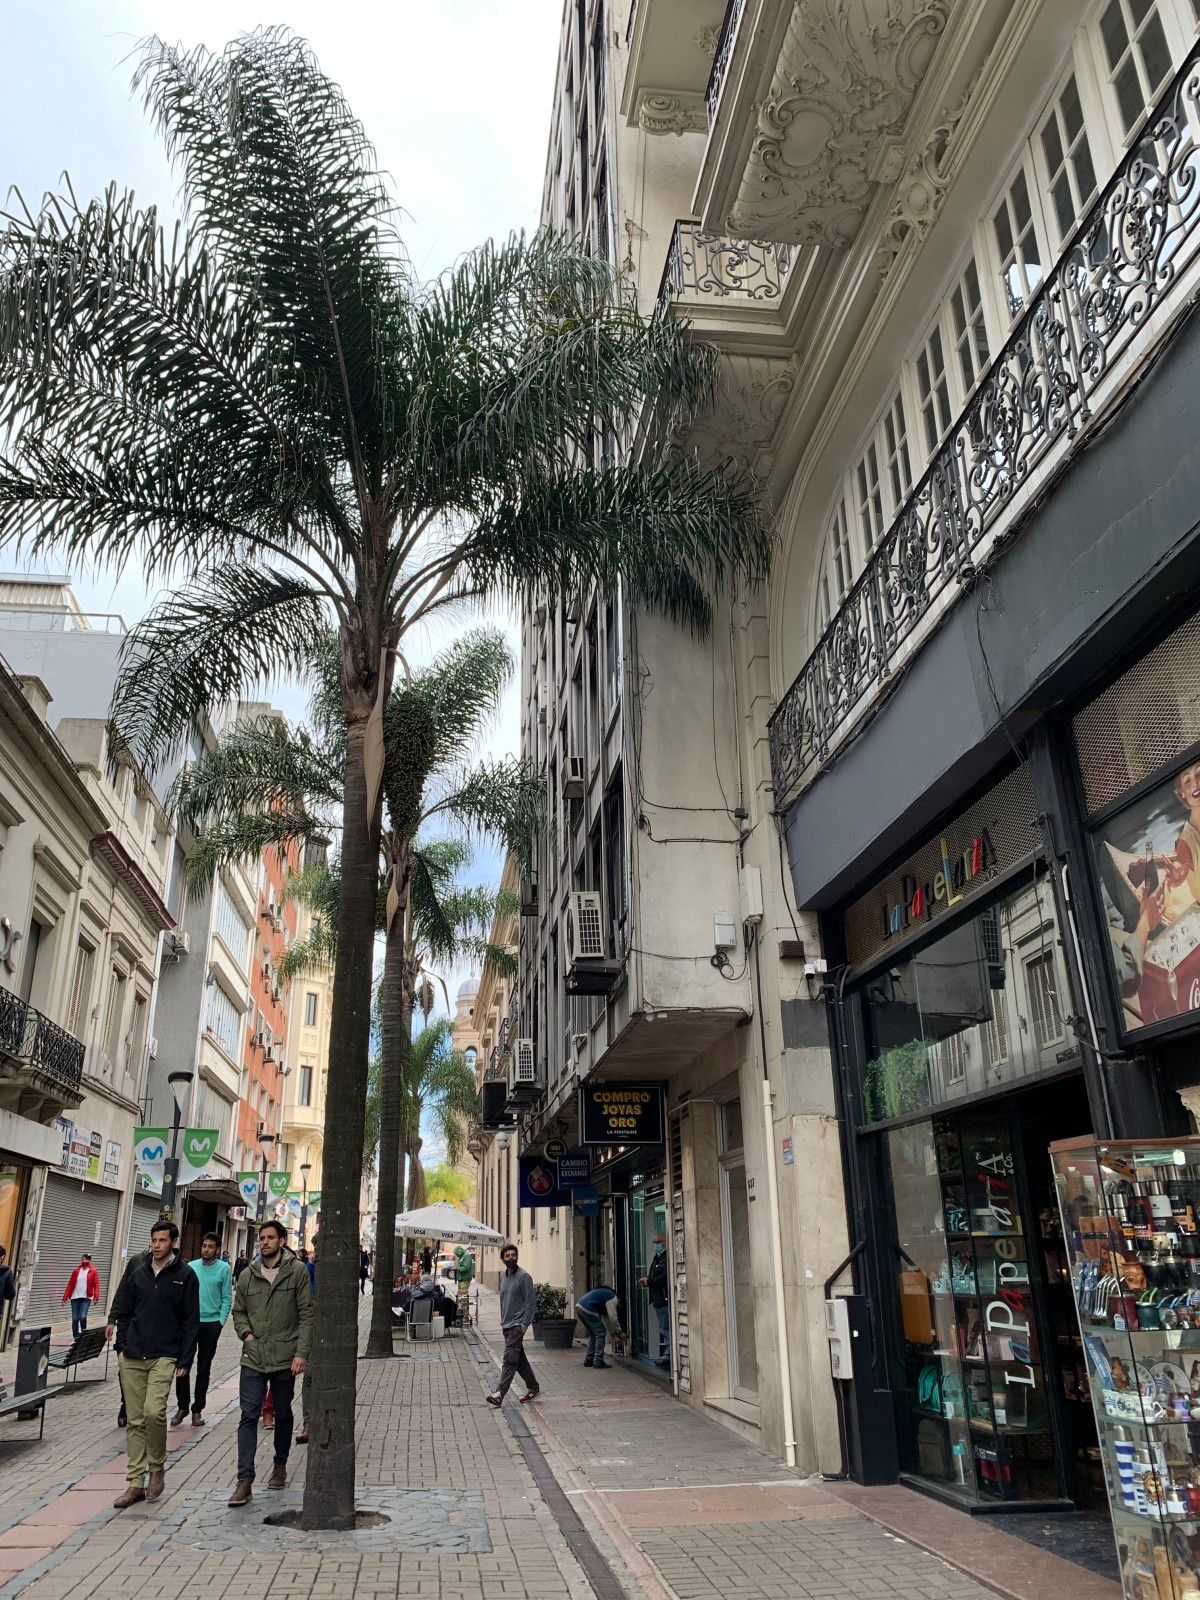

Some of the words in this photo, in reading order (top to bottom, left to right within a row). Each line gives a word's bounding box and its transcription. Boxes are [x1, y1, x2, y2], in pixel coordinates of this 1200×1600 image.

[593, 1091, 649, 1102] COMPRO
[602, 1104, 642, 1115] JOYAS
[608, 1117, 637, 1127] ORO
